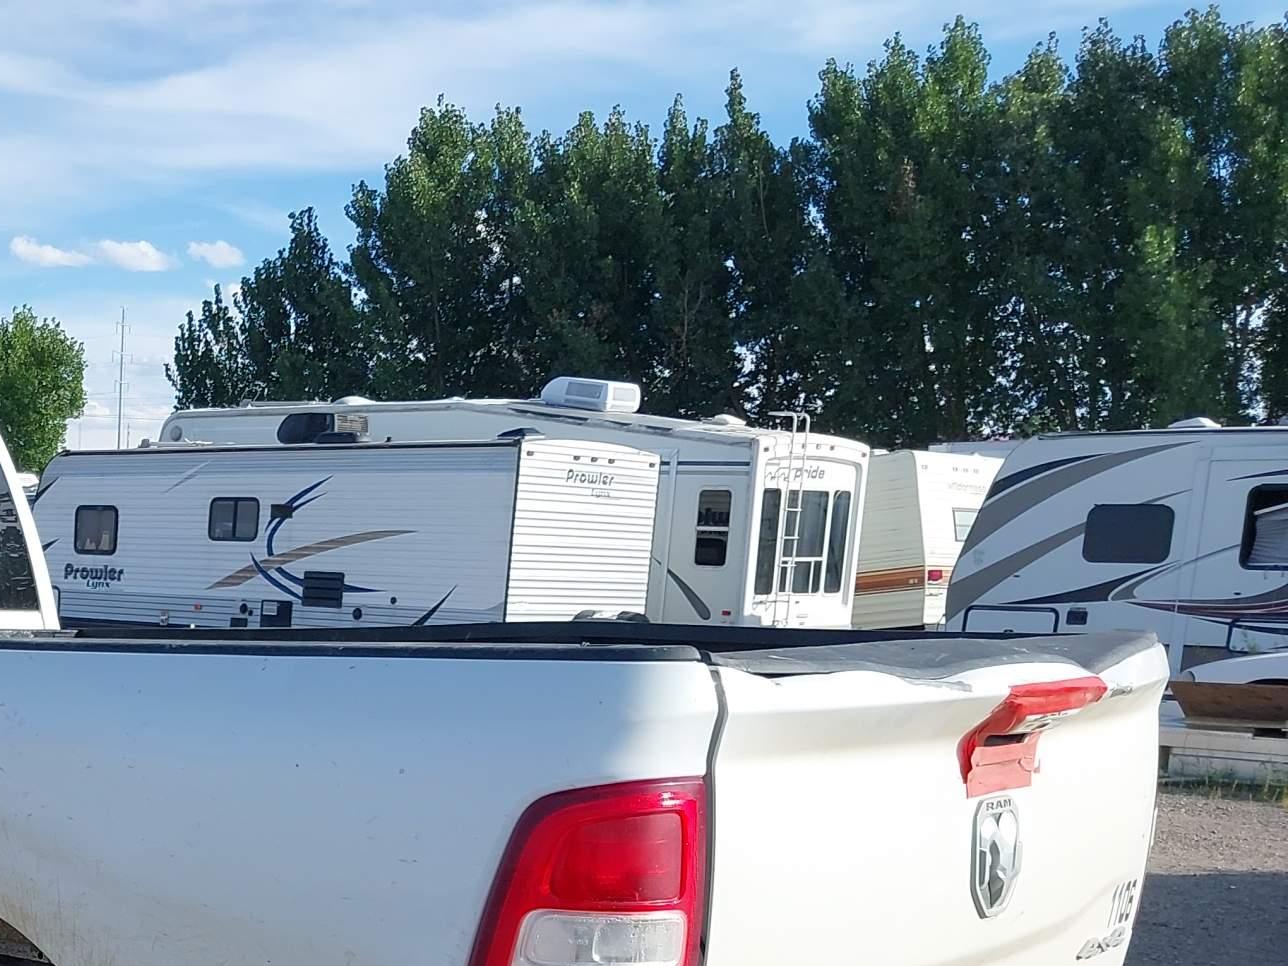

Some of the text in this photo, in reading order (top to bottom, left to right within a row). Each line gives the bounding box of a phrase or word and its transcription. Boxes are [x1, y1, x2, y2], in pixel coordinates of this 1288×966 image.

[565, 469, 614, 486] Prowler
[64, 563, 124, 581] Prowler
[86, 579, 111, 589] Lynx
[986, 799, 1012, 811] RAM
[1107, 879, 1138, 929] 1106
